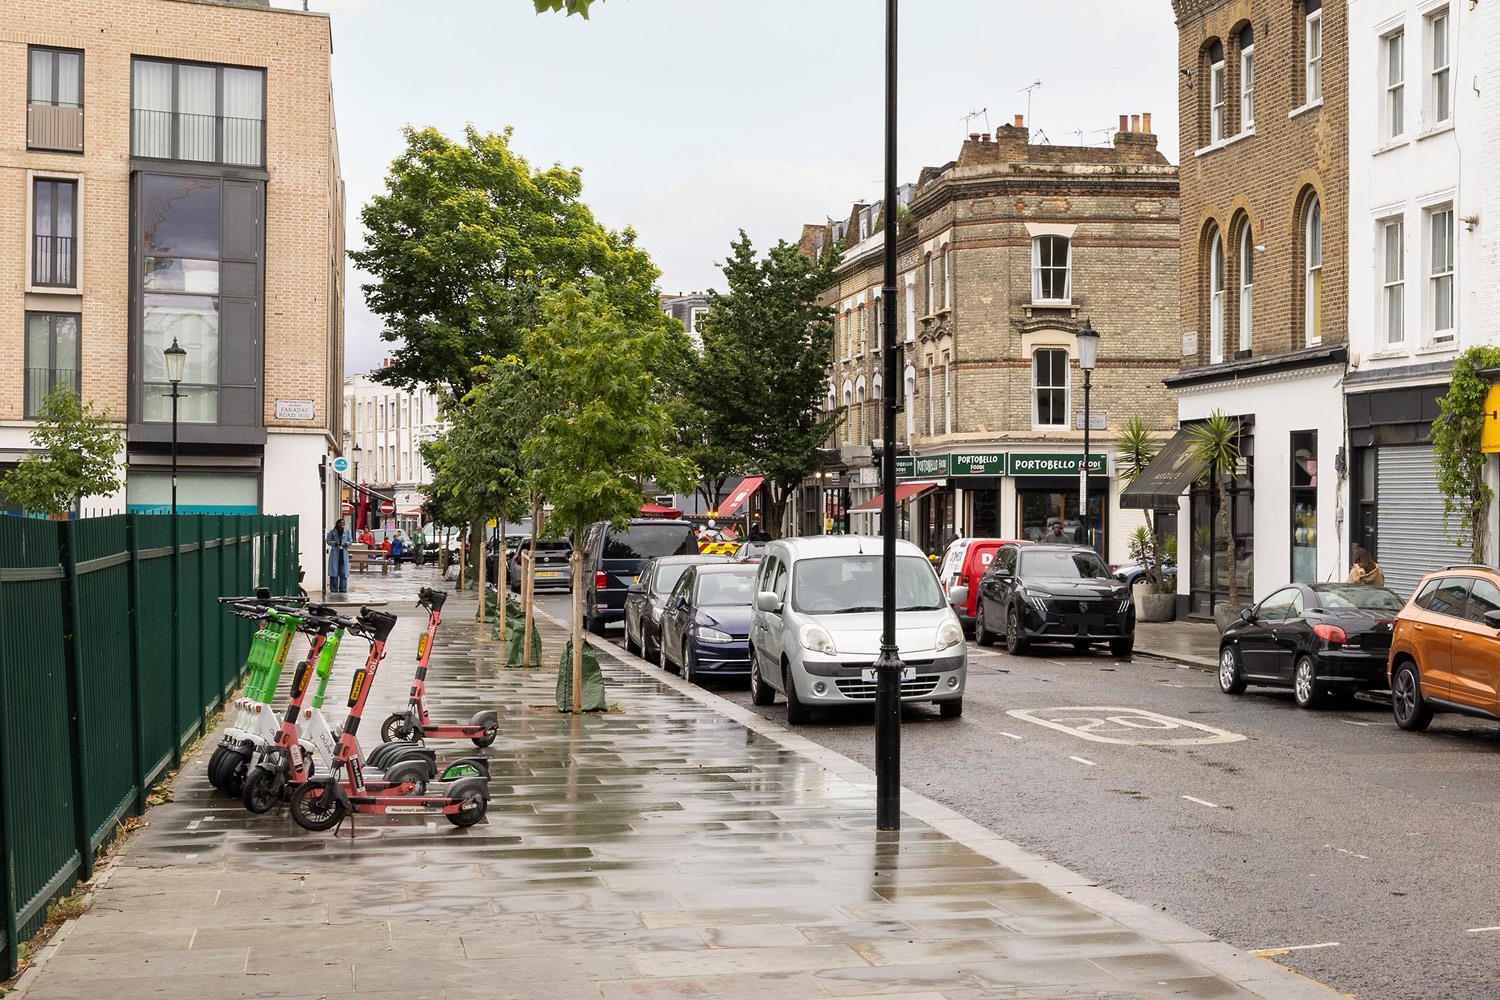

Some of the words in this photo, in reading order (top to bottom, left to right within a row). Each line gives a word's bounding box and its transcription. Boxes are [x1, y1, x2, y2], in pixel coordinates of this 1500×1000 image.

[957, 456, 998, 464] PORTOBELLO
[1015, 459, 1076, 470] PORTOBELLO
[1050, 716, 1179, 732] 20
